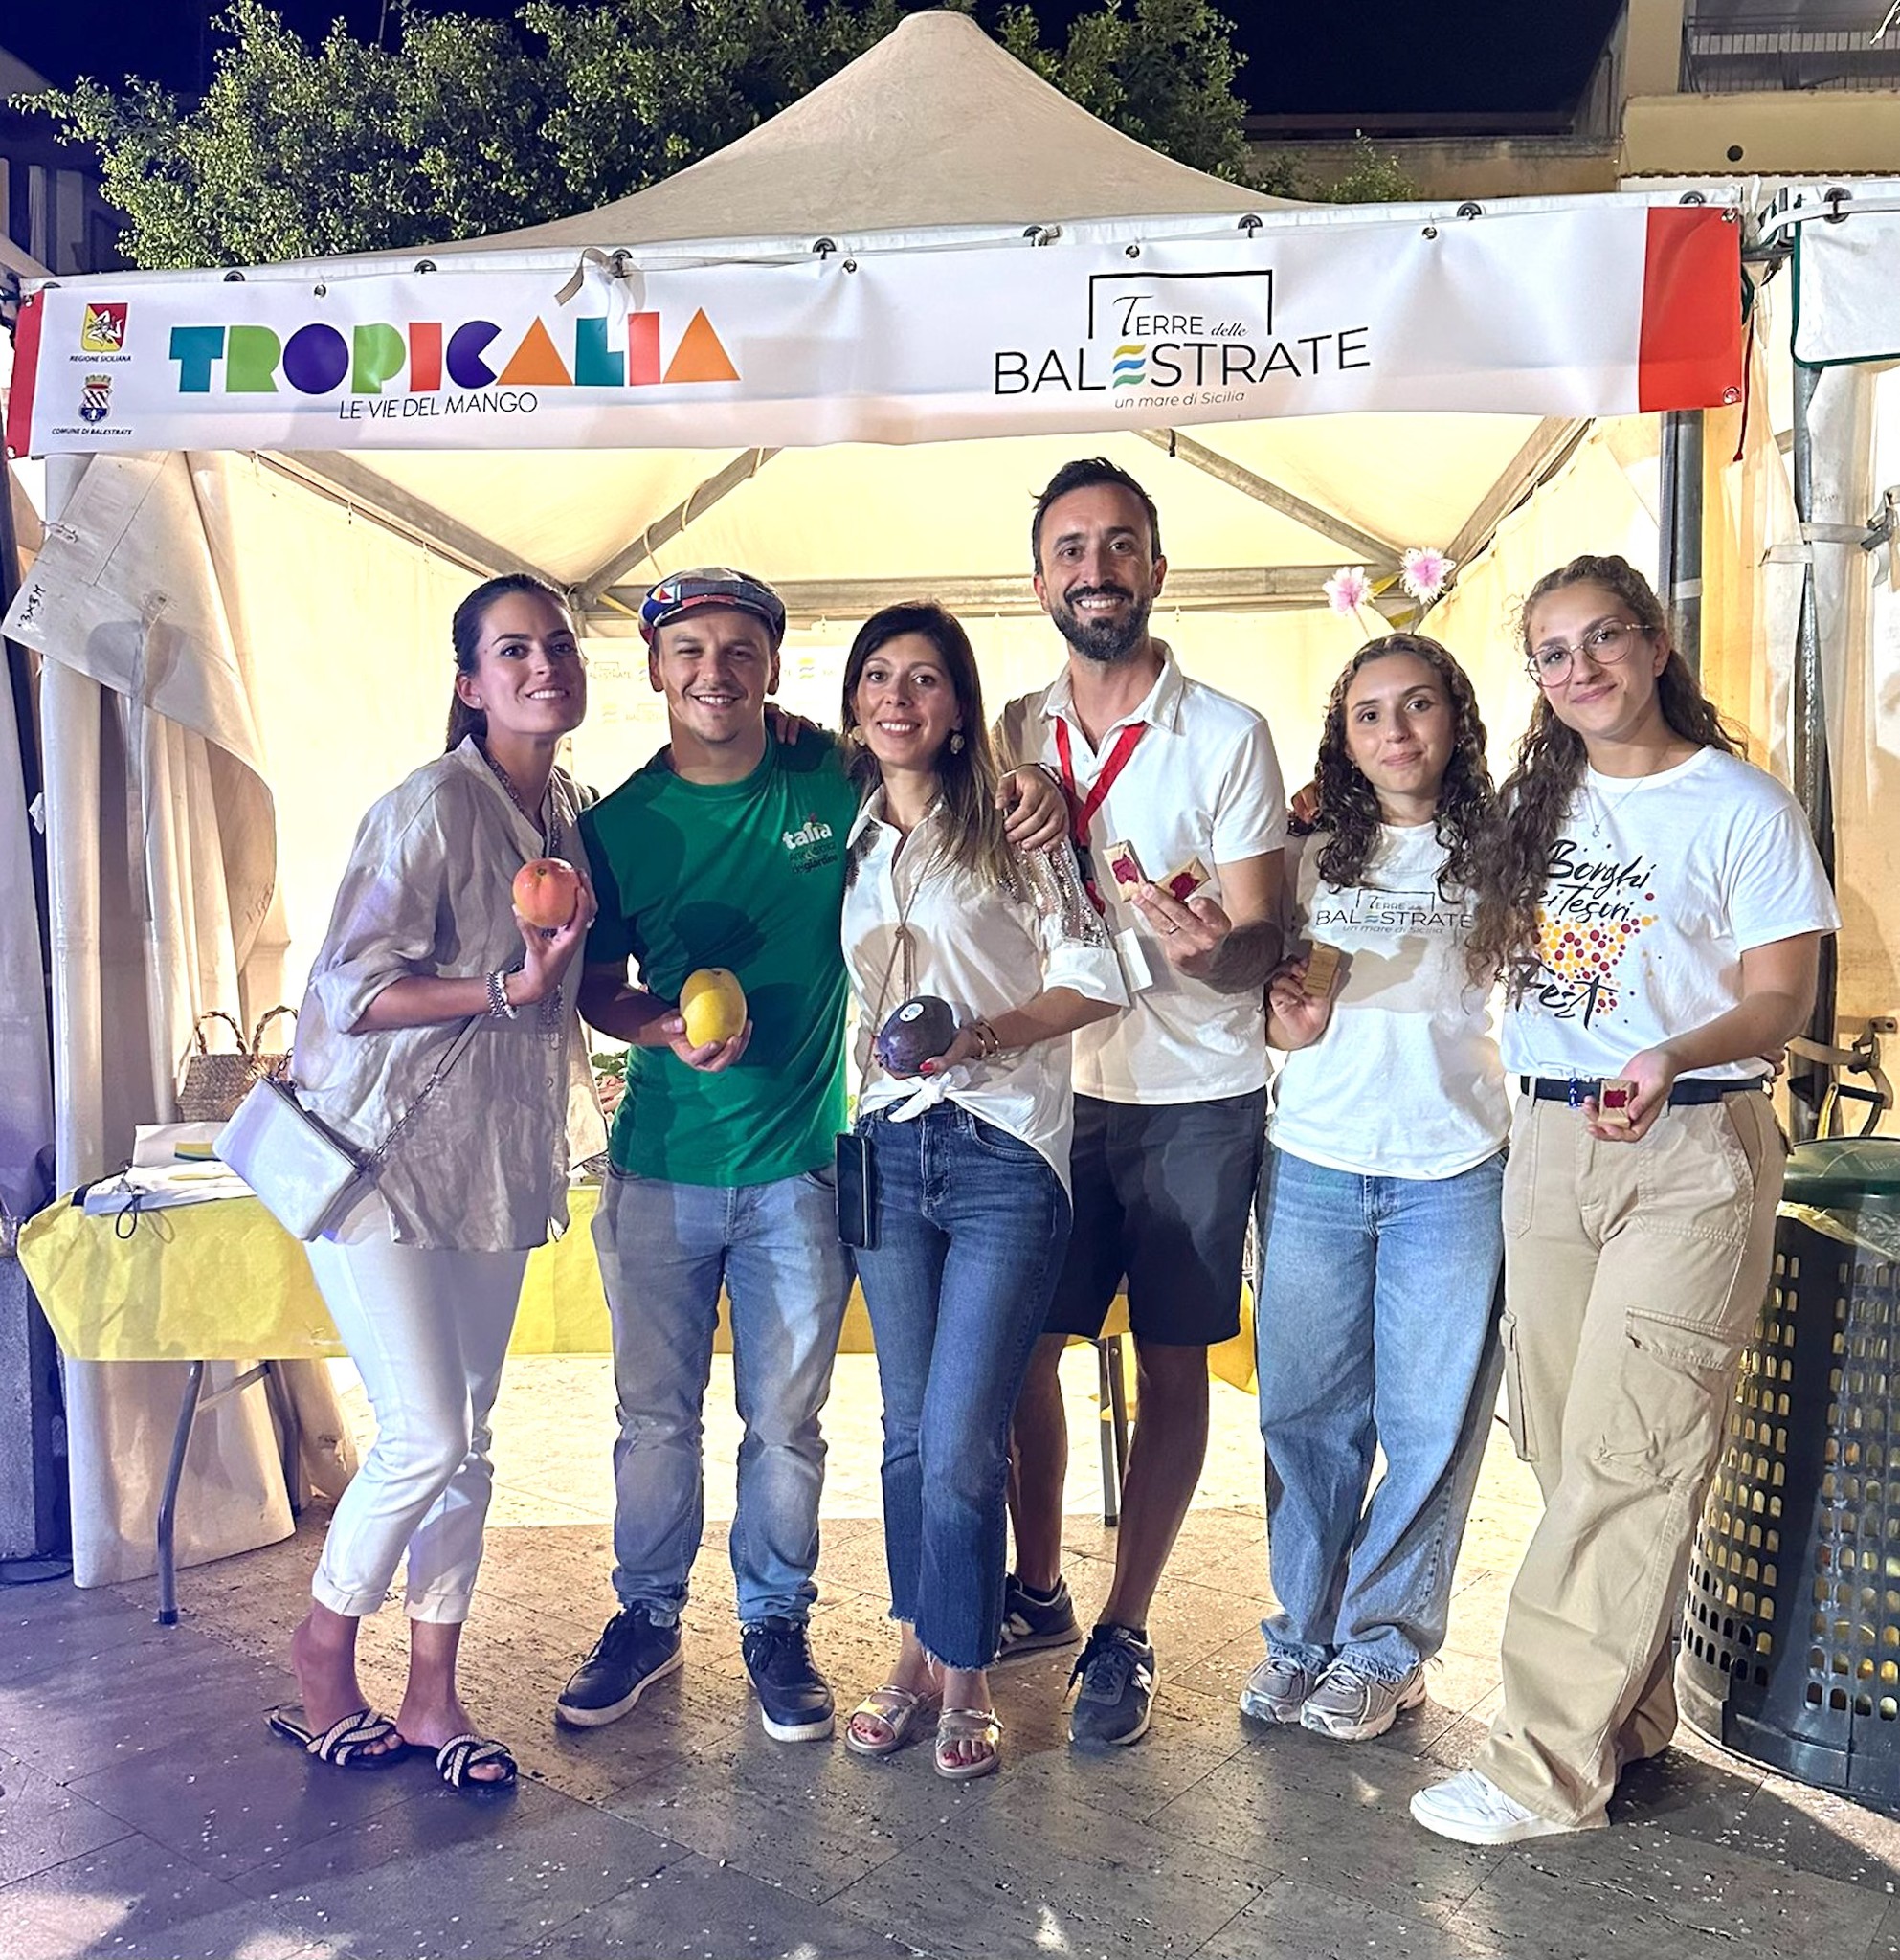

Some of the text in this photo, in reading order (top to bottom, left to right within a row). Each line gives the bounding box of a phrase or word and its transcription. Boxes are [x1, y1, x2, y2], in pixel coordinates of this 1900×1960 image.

[1113, 295, 1248, 338] TERRE delle
[169, 306, 742, 395] TROPICALIA
[995, 327, 1371, 395] BALESTRATE
[339, 391, 538, 419] LE VIE DEL MANGO
[1114, 391, 1245, 409] un mare di Sicilia
[1548, 839, 1657, 900] Borghi
[1315, 908, 1474, 930] BALESTRATE
[1368, 894, 1407, 910] TERRE
[1534, 883, 1636, 924] ei Tesori
[1359, 924, 1391, 934] mare
